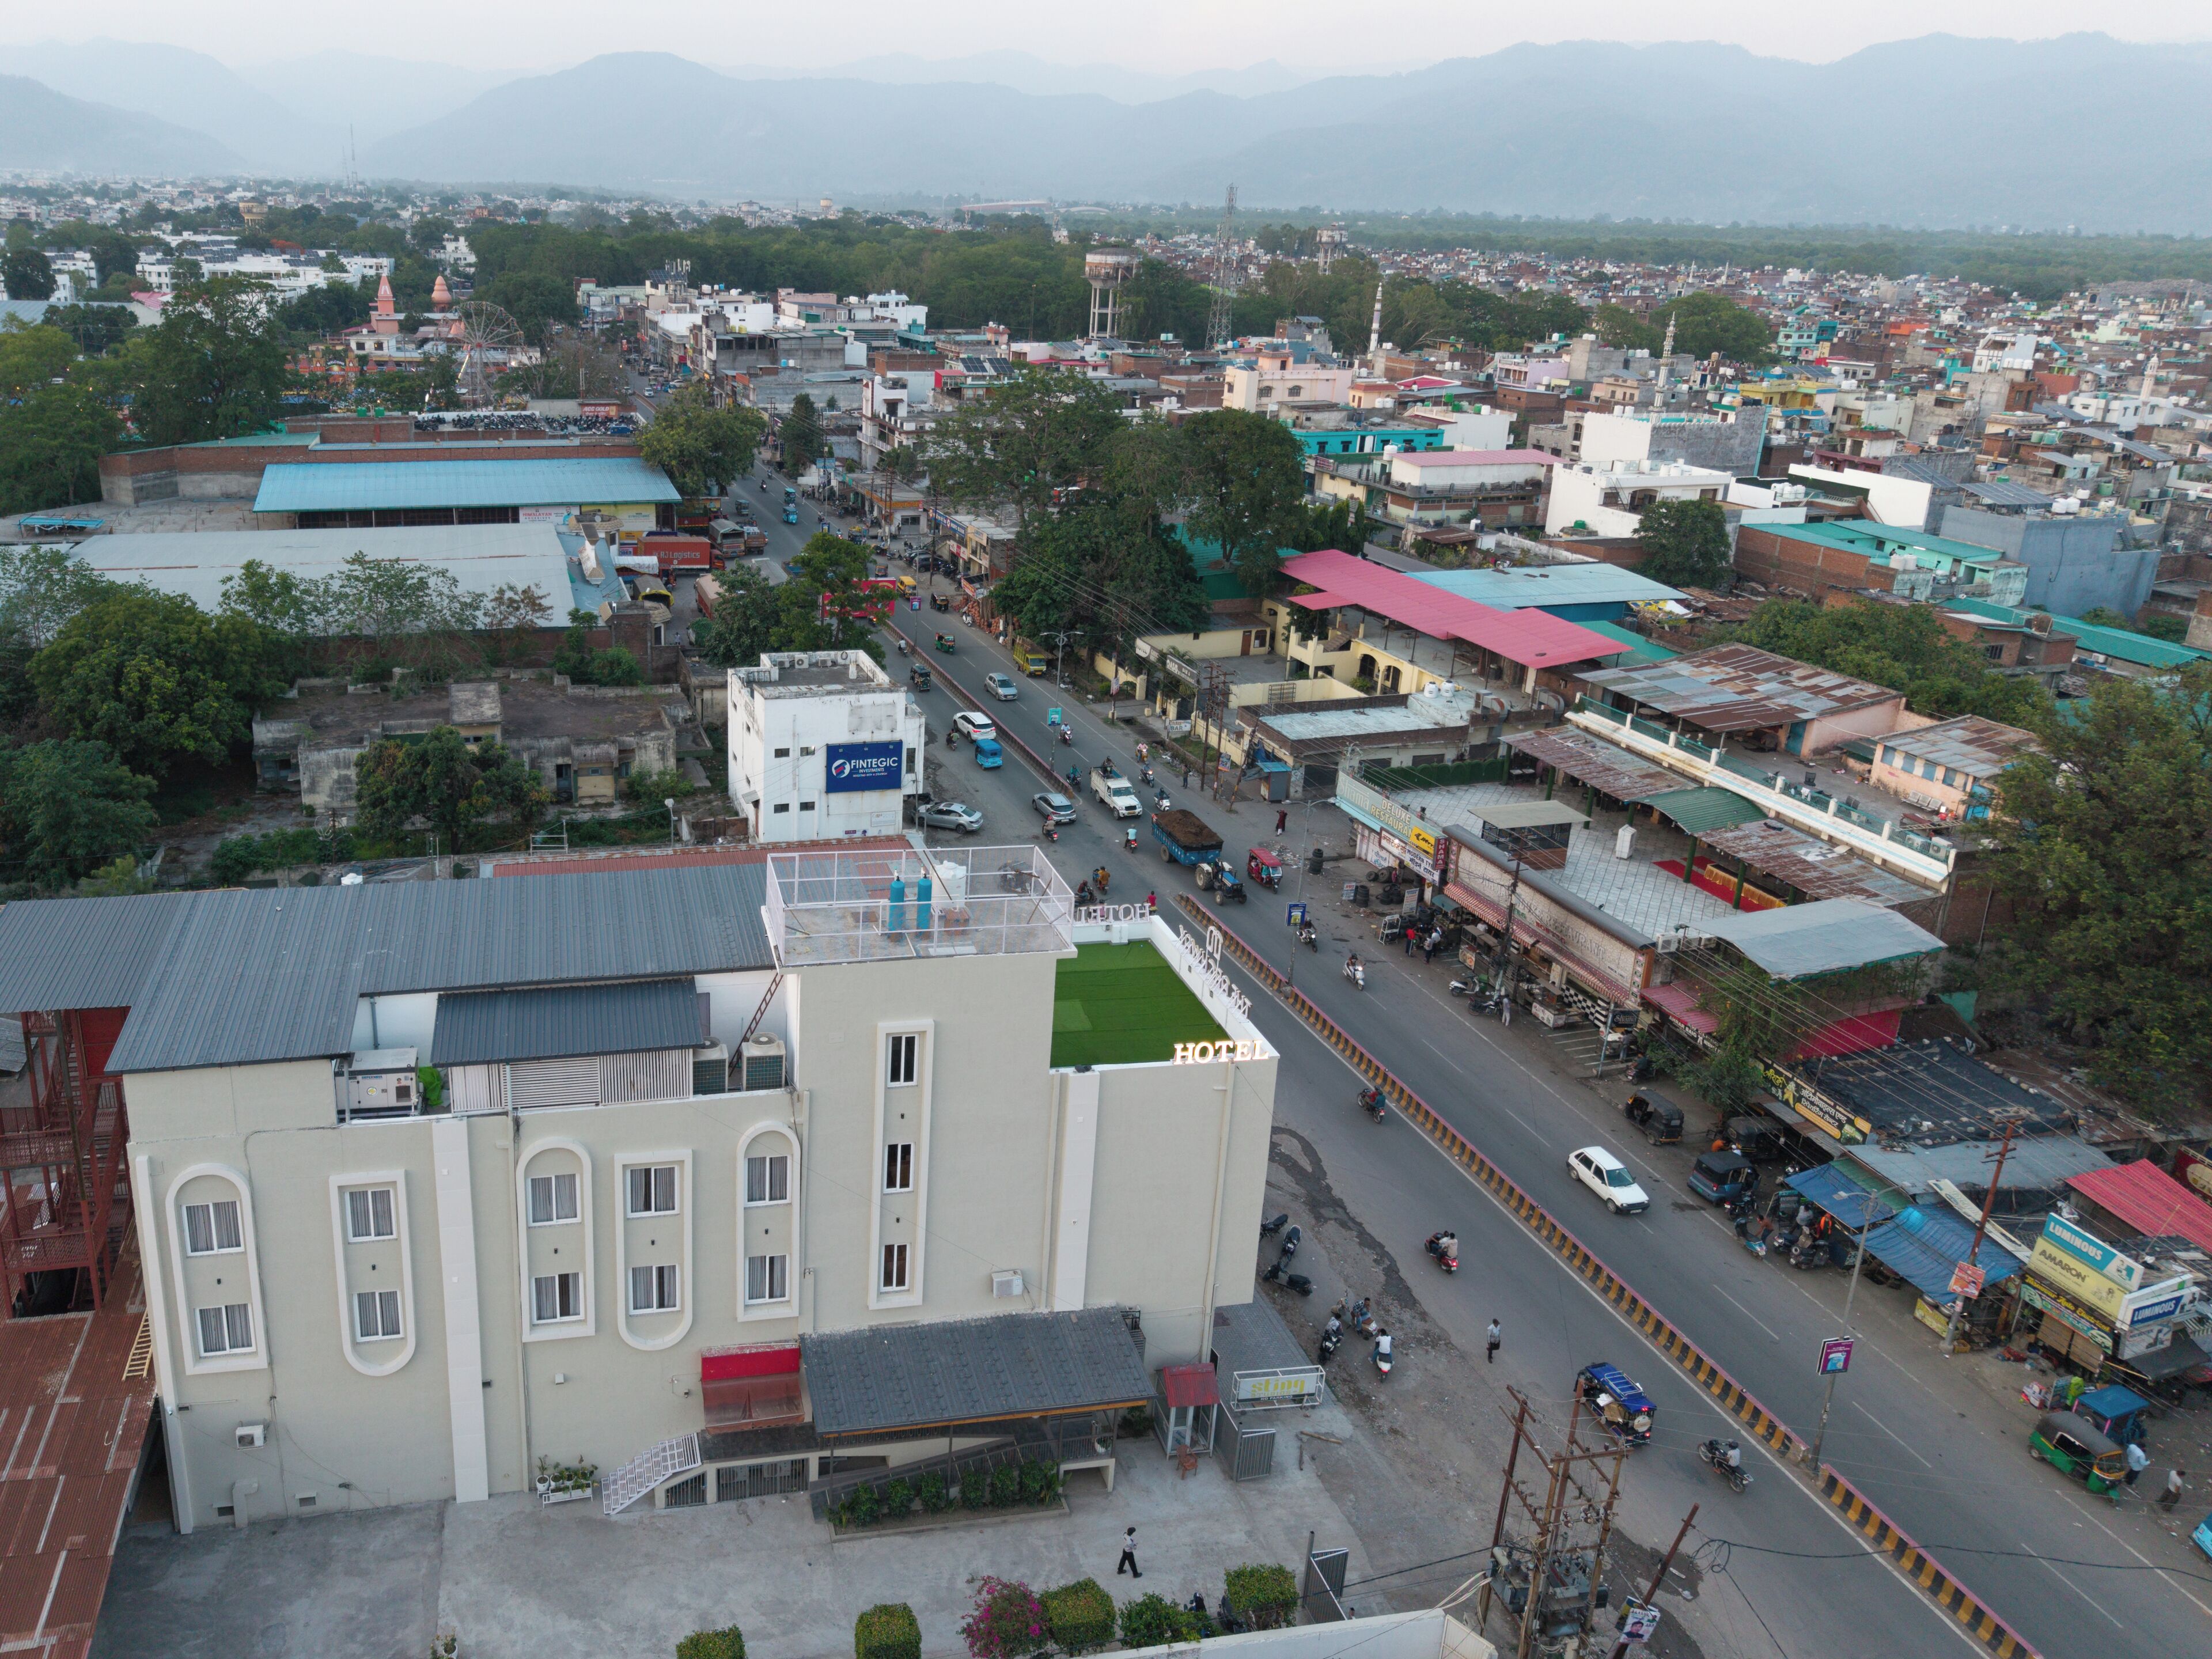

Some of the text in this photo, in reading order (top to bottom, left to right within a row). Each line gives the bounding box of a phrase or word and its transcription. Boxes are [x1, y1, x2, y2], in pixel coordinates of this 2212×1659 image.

[669, 551, 700, 560] Logistics
[851, 757, 898, 769] FINTEGIC
[1337, 777, 1369, 811] Shama
[1382, 799, 1411, 825] DELUXE
[1407, 849, 1425, 863] MODERN
[1437, 839, 1445, 864] SHAMA
[1173, 1040, 1270, 1065] HOTEL
[2048, 1222, 2103, 1261] LUMINOUS
[2039, 1249, 2088, 1283] AMARON
[2056, 1296, 2075, 1310] Auto
[2133, 1300, 2176, 1321] LUMINOUS
